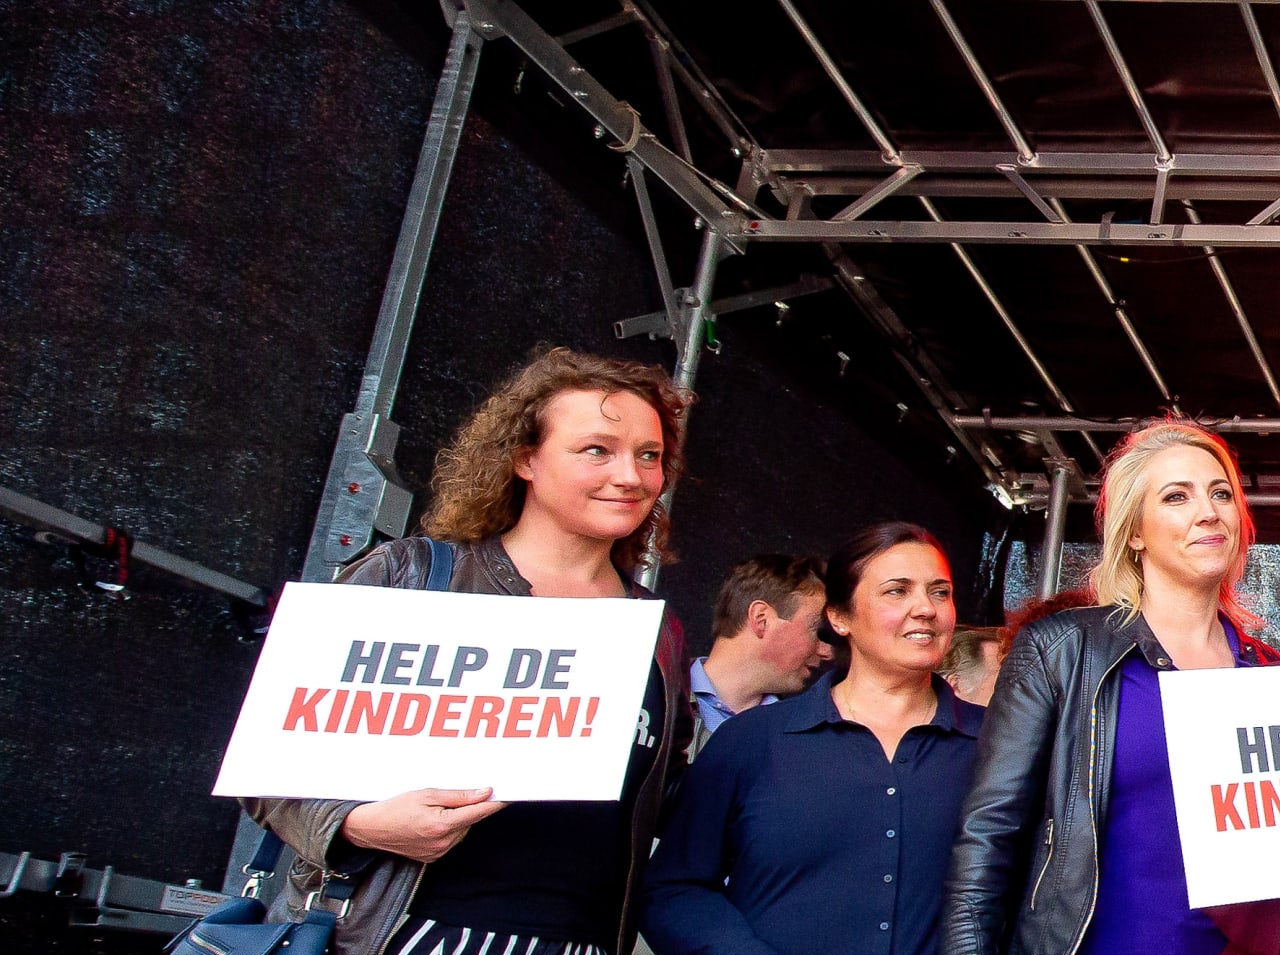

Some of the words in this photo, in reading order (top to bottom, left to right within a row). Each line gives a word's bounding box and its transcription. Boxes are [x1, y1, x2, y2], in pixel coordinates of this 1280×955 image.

[340, 640, 488, 687] HELP
[503, 649, 576, 689] DE
[283, 688, 599, 738] KINDEREN!
